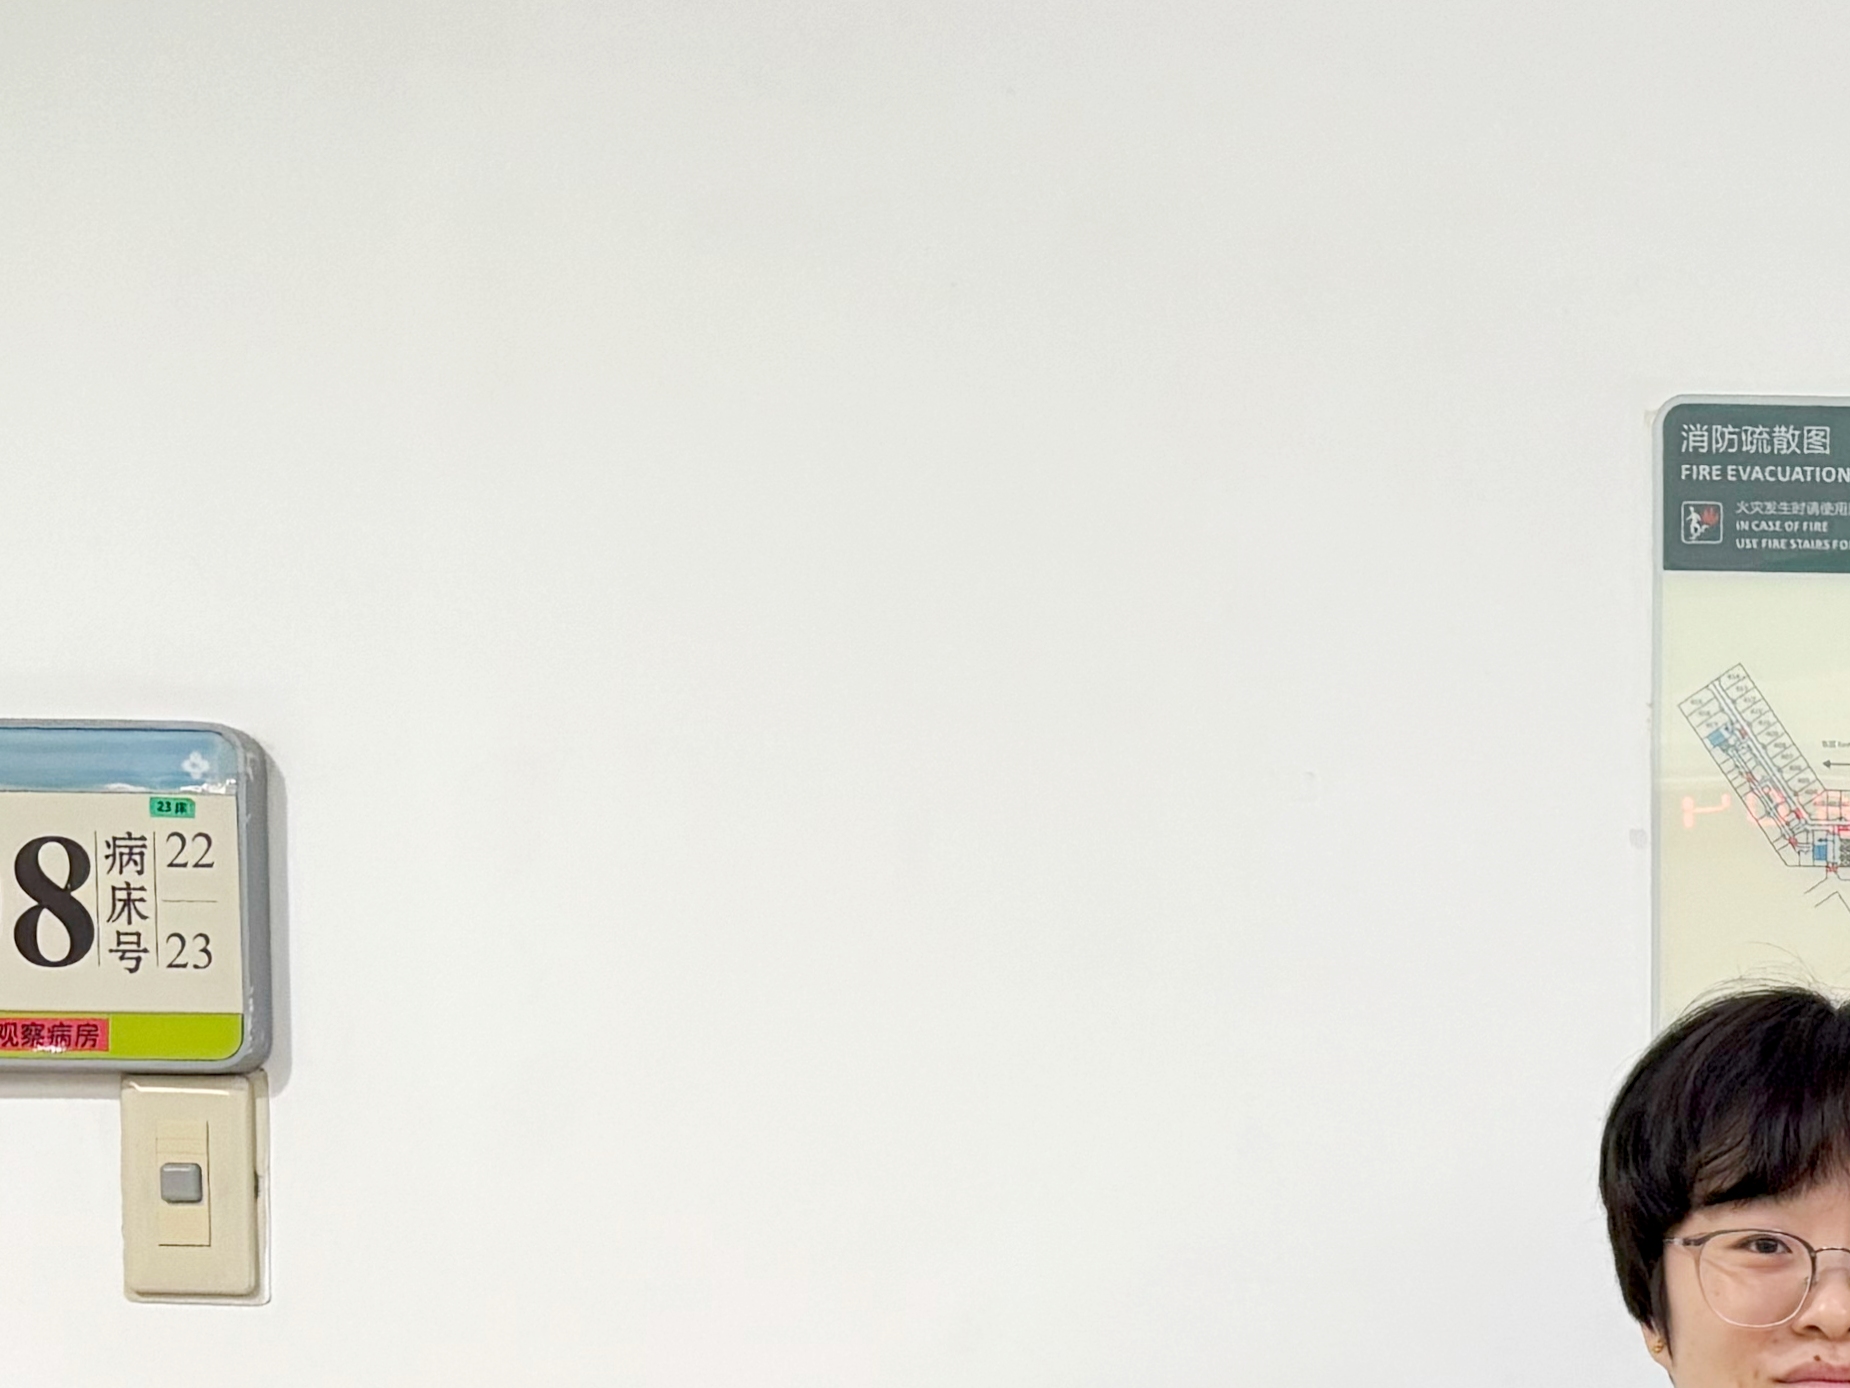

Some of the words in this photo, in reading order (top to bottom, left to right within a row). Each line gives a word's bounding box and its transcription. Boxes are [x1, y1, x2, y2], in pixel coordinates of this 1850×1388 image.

[1680, 425, 1831, 455] 消防疏散图
[1680, 464, 1722, 481] FIRE
[1725, 466, 1850, 483] EVACUATION
[1736, 521, 1749, 531] IN
[1752, 521, 1782, 532] CASE
[1785, 522, 1800, 532] OF
[1803, 522, 1828, 532] FIRE
[1736, 538, 1758, 549] USE
[1761, 539, 1788, 549] FIRE
[1790, 539, 1830, 550] STAIRS
[166, 831, 216, 869] 22
[14, 835, 95, 968] 8
[104, 831, 150, 974] 病床号
[165, 932, 213, 969] 23
